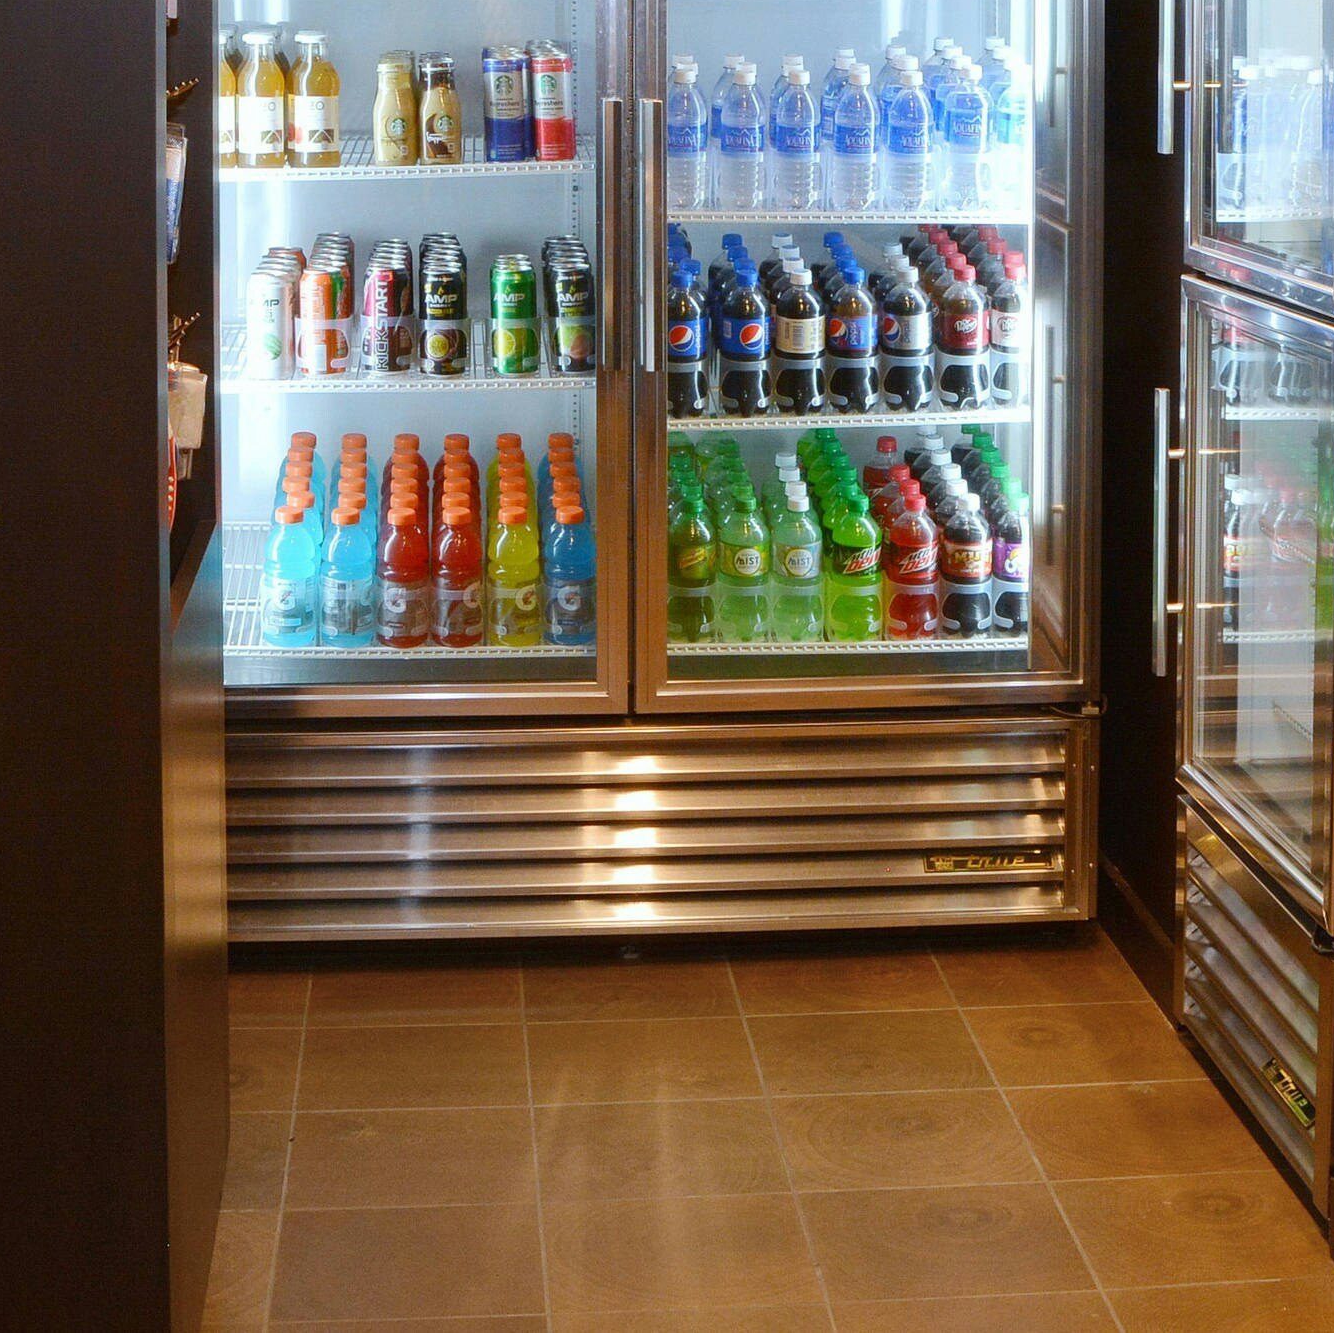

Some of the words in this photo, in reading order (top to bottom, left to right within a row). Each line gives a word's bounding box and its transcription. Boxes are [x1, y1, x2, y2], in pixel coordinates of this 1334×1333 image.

[953, 120, 981, 135] AQUAFIN
[424, 293, 458, 303] AMP
[493, 292, 525, 302] AMP
[557, 292, 589, 302] AMP
[374, 277, 390, 370] KICKSTART
